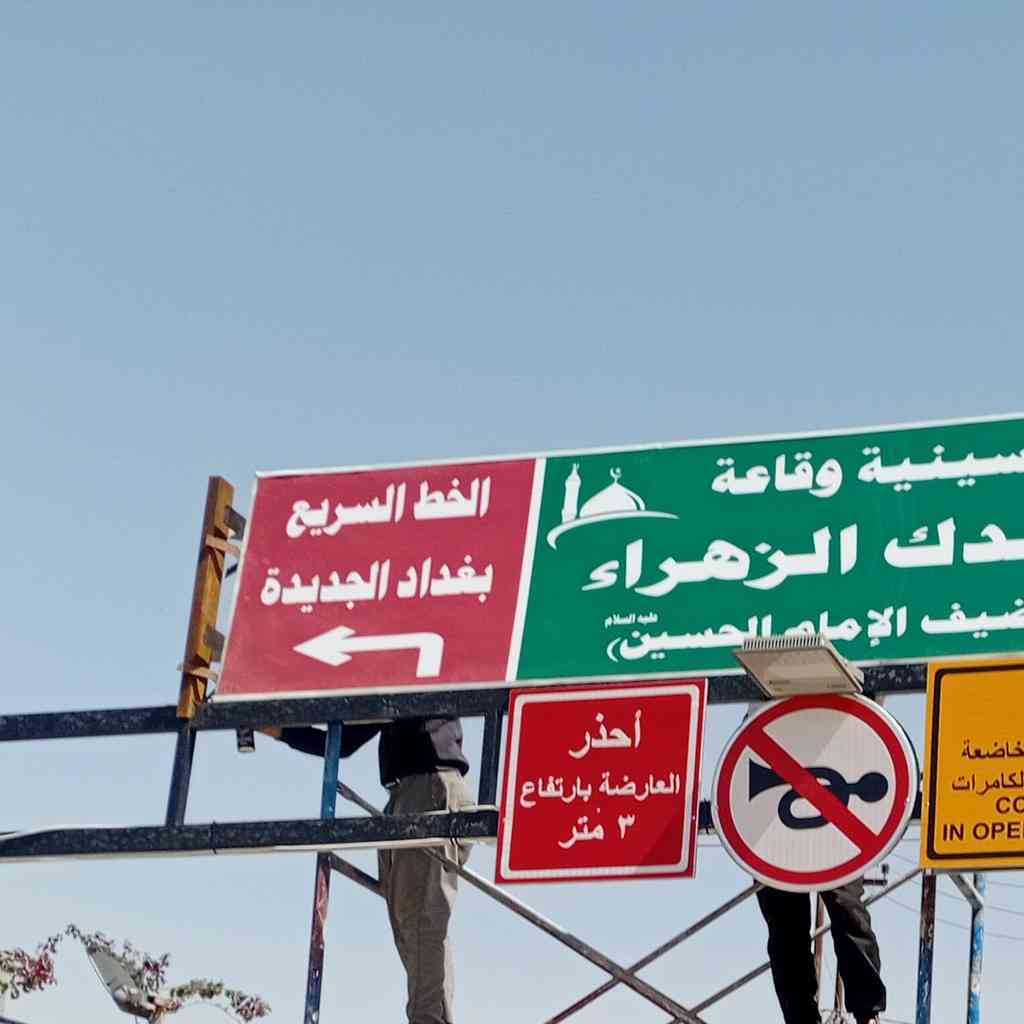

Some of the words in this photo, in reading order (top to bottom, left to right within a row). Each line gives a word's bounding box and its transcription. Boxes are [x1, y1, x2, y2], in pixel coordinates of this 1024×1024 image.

[414, 476, 491, 520] الخط
[711, 452, 843, 498] وقاعة
[286, 481, 407, 538] السريع
[397, 554, 494, 603] بغداد
[581, 523, 858, 597] الزهراء
[260, 558, 391, 613] الجديدة
[568, 709, 642, 759] أحذر
[519, 775, 592, 808] بارتفاع
[599, 771, 681, 801] العارضة
[558, 815, 604, 848] متر
[942, 823, 964, 841] IN
